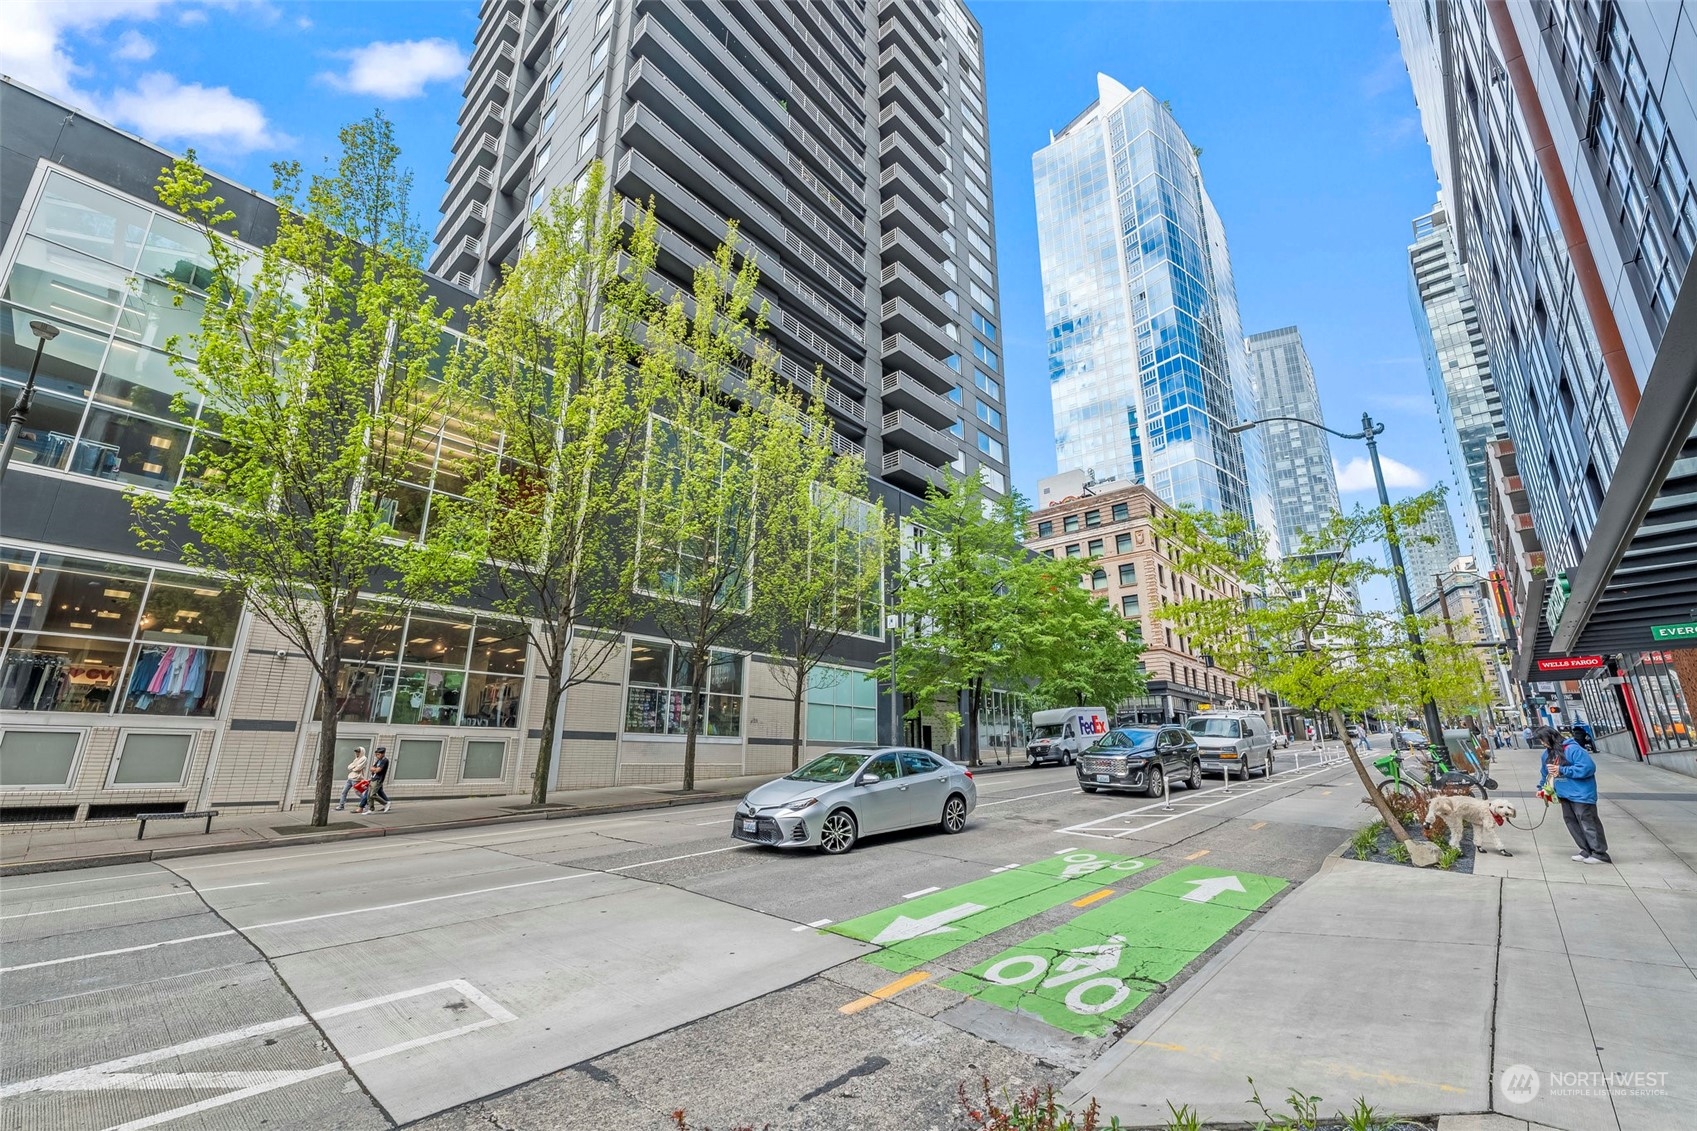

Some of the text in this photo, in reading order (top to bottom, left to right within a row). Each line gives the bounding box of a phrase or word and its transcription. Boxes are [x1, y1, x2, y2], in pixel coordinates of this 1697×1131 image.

[1659, 626, 1697, 637] EVER
[1542, 658, 1598, 668] WELLS FARGO
[1078, 715, 1106, 735] FedEx
